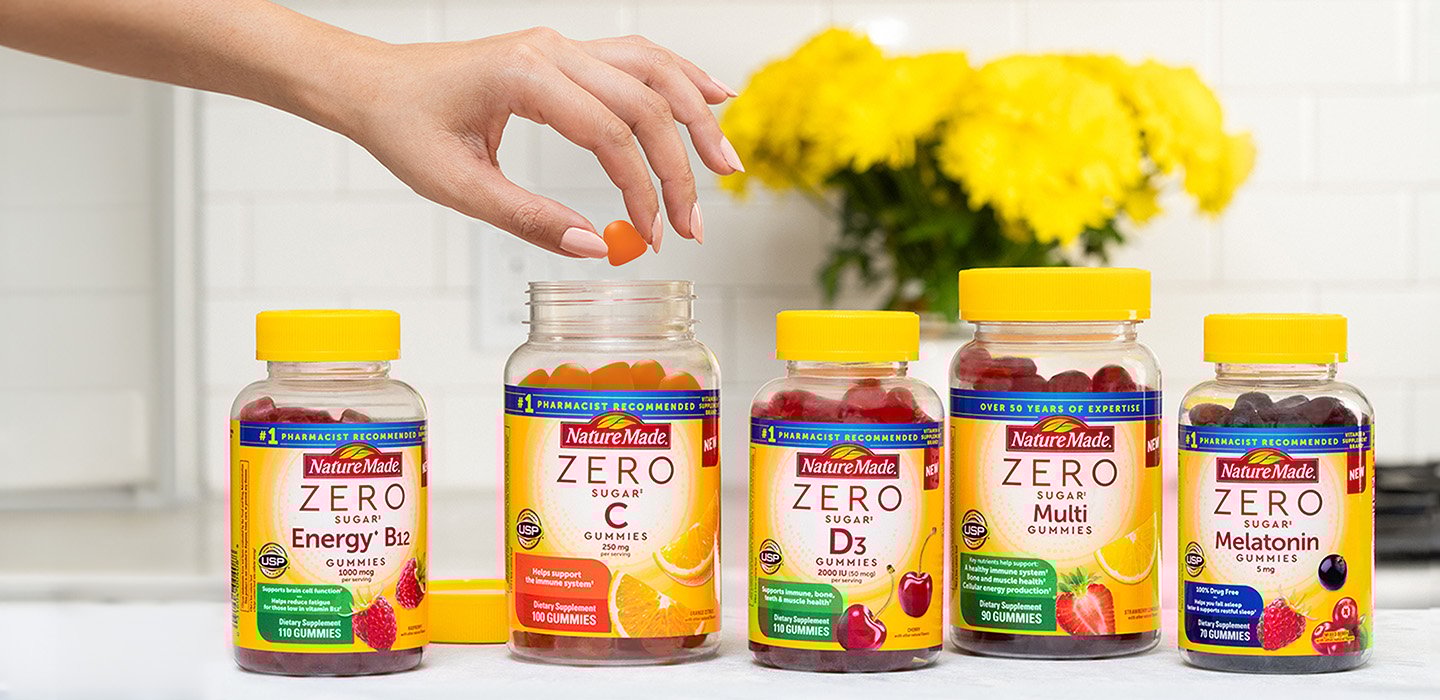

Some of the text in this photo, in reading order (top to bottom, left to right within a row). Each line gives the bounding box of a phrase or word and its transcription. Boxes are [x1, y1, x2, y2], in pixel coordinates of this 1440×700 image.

[518, 394, 534, 413] #1
[537, 400, 608, 410] PHARMACIST
[614, 401, 695, 410] RECOMMENDED
[980, 403, 1140, 413] OVER 50 YEARS OF EXPERTISE
[259, 428, 278, 444] #1
[281, 433, 348, 441] PHARMACIST
[353, 432, 416, 440] RECOMMENDED
[762, 426, 776, 443] #1
[778, 431, 840, 441] PHARMACIST
[845, 434, 918, 442] RECOMMENDED
[1185, 432, 1339, 448] #1 PHARMACIST RECOMMENDED
[704, 436, 717, 452] NEW
[1147, 436, 1160, 452] NEW
[557, 455, 674, 484] ZERO
[925, 463, 939, 477] NEW
[1002, 458, 1117, 487] ZERO
[1350, 467, 1364, 481] NEW
[299, 483, 405, 511] ZERO
[792, 484, 902, 511] ZERO
[1214, 489, 1323, 516] ZERO
[605, 502, 628, 528] C
[1034, 504, 1087, 522] Multi
[519, 525, 539, 536] USP
[964, 525, 985, 537] USP
[1028, 526, 1092, 534] GUMMIES
[385, 527, 410, 546] B12
[584, 532, 648, 541] GUMMIES
[830, 528, 866, 555] D3
[1215, 531, 1319, 551] Melatonin
[261, 556, 285, 566] USP
[326, 558, 385, 567] GUMMIES
[761, 551, 779, 562] USP
[816, 558, 878, 567] GUMMIES
[1187, 555, 1202, 565] USP
[1236, 554, 1298, 562] GUMMIES
[532, 568, 550, 576] Helps
[969, 565, 989, 574] healthy
[990, 567, 1017, 575] immune
[526, 576, 534, 584] the
[536, 578, 562, 586] immune
[967, 573, 979, 581] Bone
[762, 586, 784, 595] Supports
[785, 589, 813, 598] immune,
[962, 582, 982, 590] Cellular
[983, 585, 1005, 594] energy
[1210, 588, 1224, 596] Drug
[533, 601, 596, 612] Dietary Supplement
[979, 600, 1041, 611] Dietary Supplement
[279, 618, 341, 627] Dietary Supplement
[532, 611, 596, 625] 100 GUMMIES
[774, 614, 829, 625] Dietary Supplement
[981, 611, 1042, 623] 90 GUMMIES
[774, 624, 829, 636] 110 GUMMIES
[1198, 619, 1250, 629] Dietary Supplement
[279, 628, 341, 638] 110 GUMMIES
[1200, 629, 1250, 640] 70 GUMMIES
